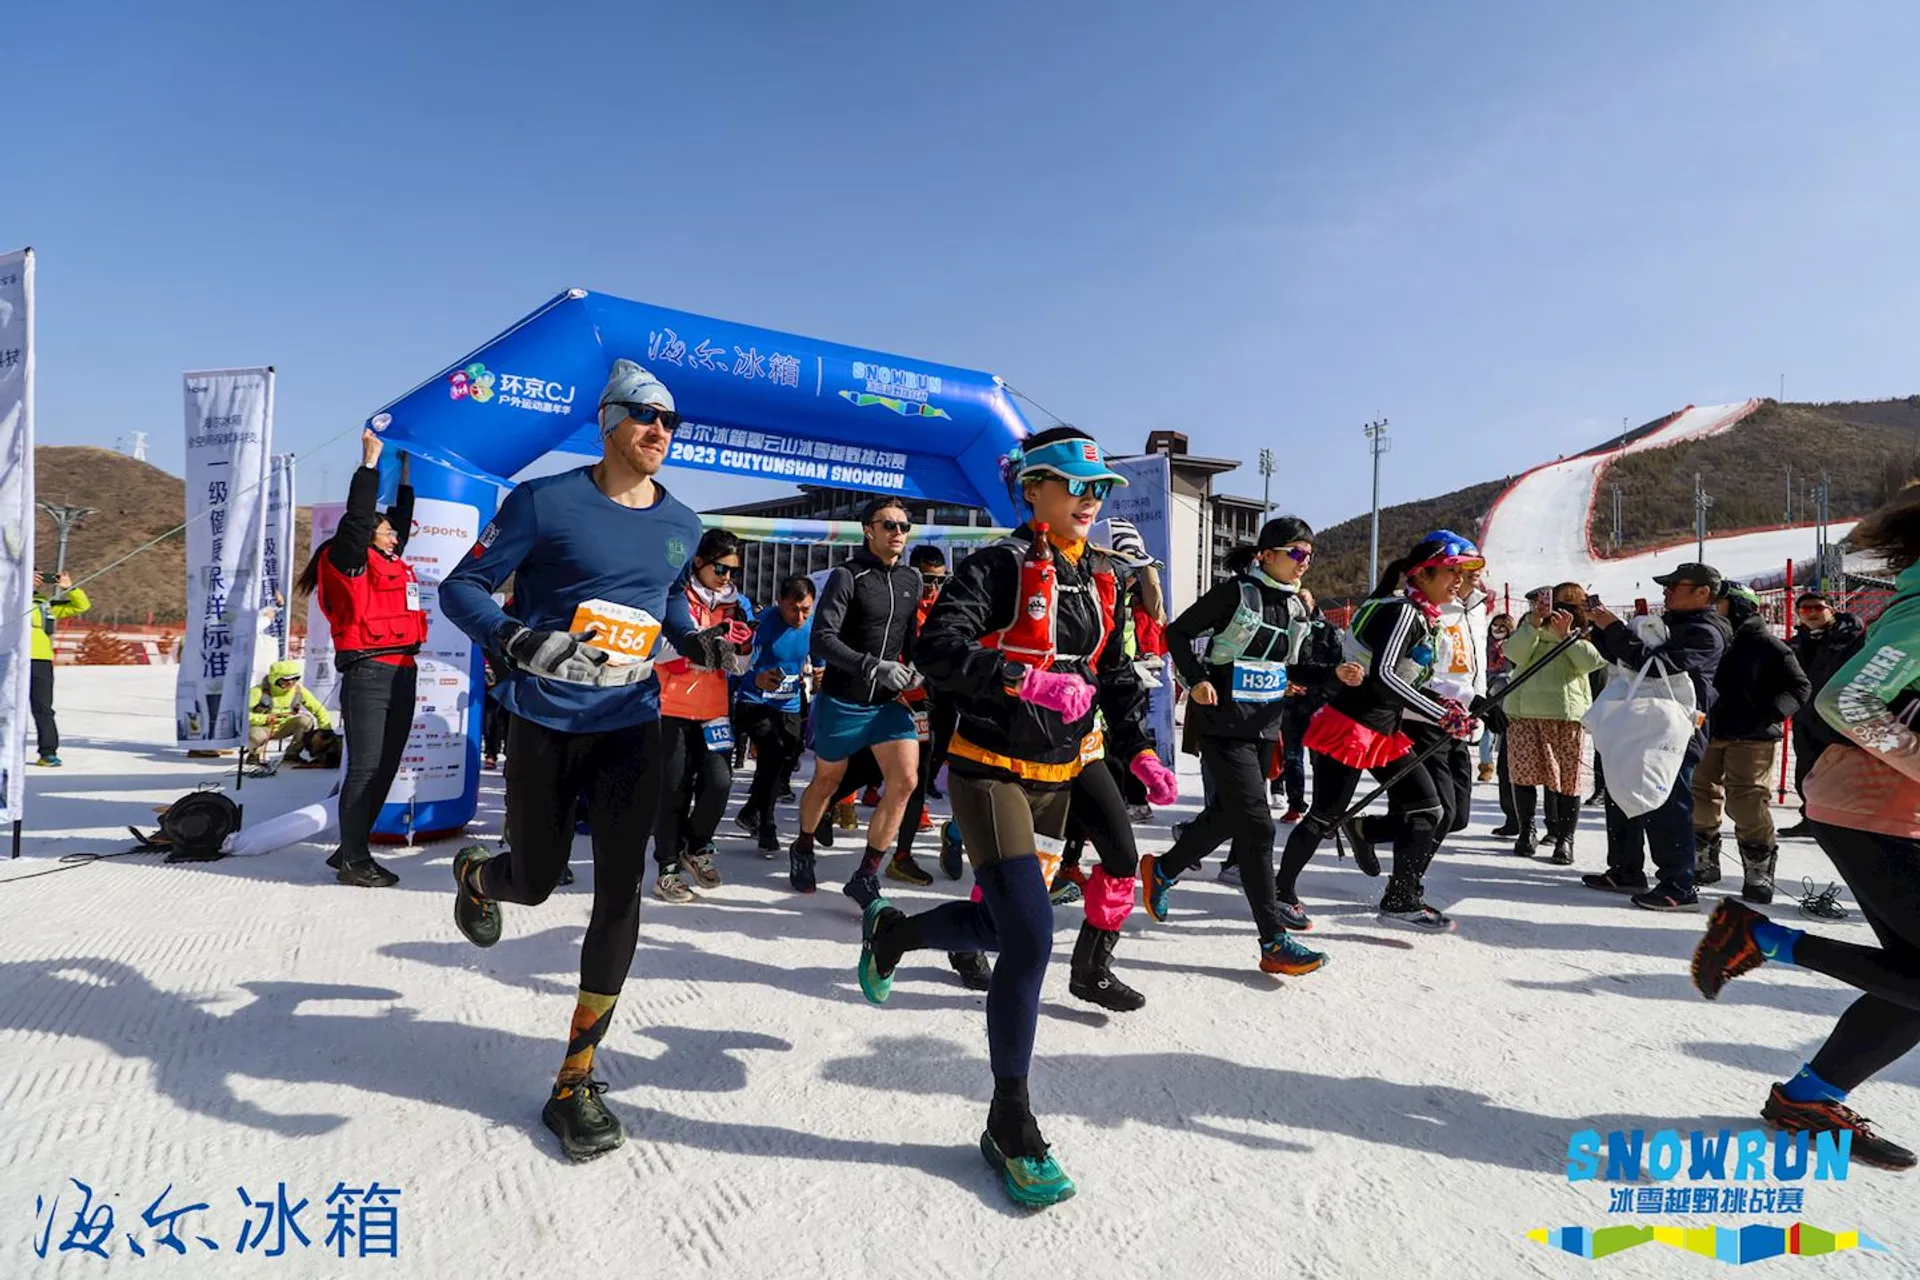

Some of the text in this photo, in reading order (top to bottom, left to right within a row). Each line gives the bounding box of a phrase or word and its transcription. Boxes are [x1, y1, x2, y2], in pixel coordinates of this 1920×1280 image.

[499, 374, 576, 404] 环京CJ
[852, 361, 942, 395] SNOWRUN
[498, 394, 572, 415] 户外运动嘉年华
[670, 443, 904, 489] 2023 CUIYUNSHAN SNOWRUN
[423, 524, 468, 538] sports
